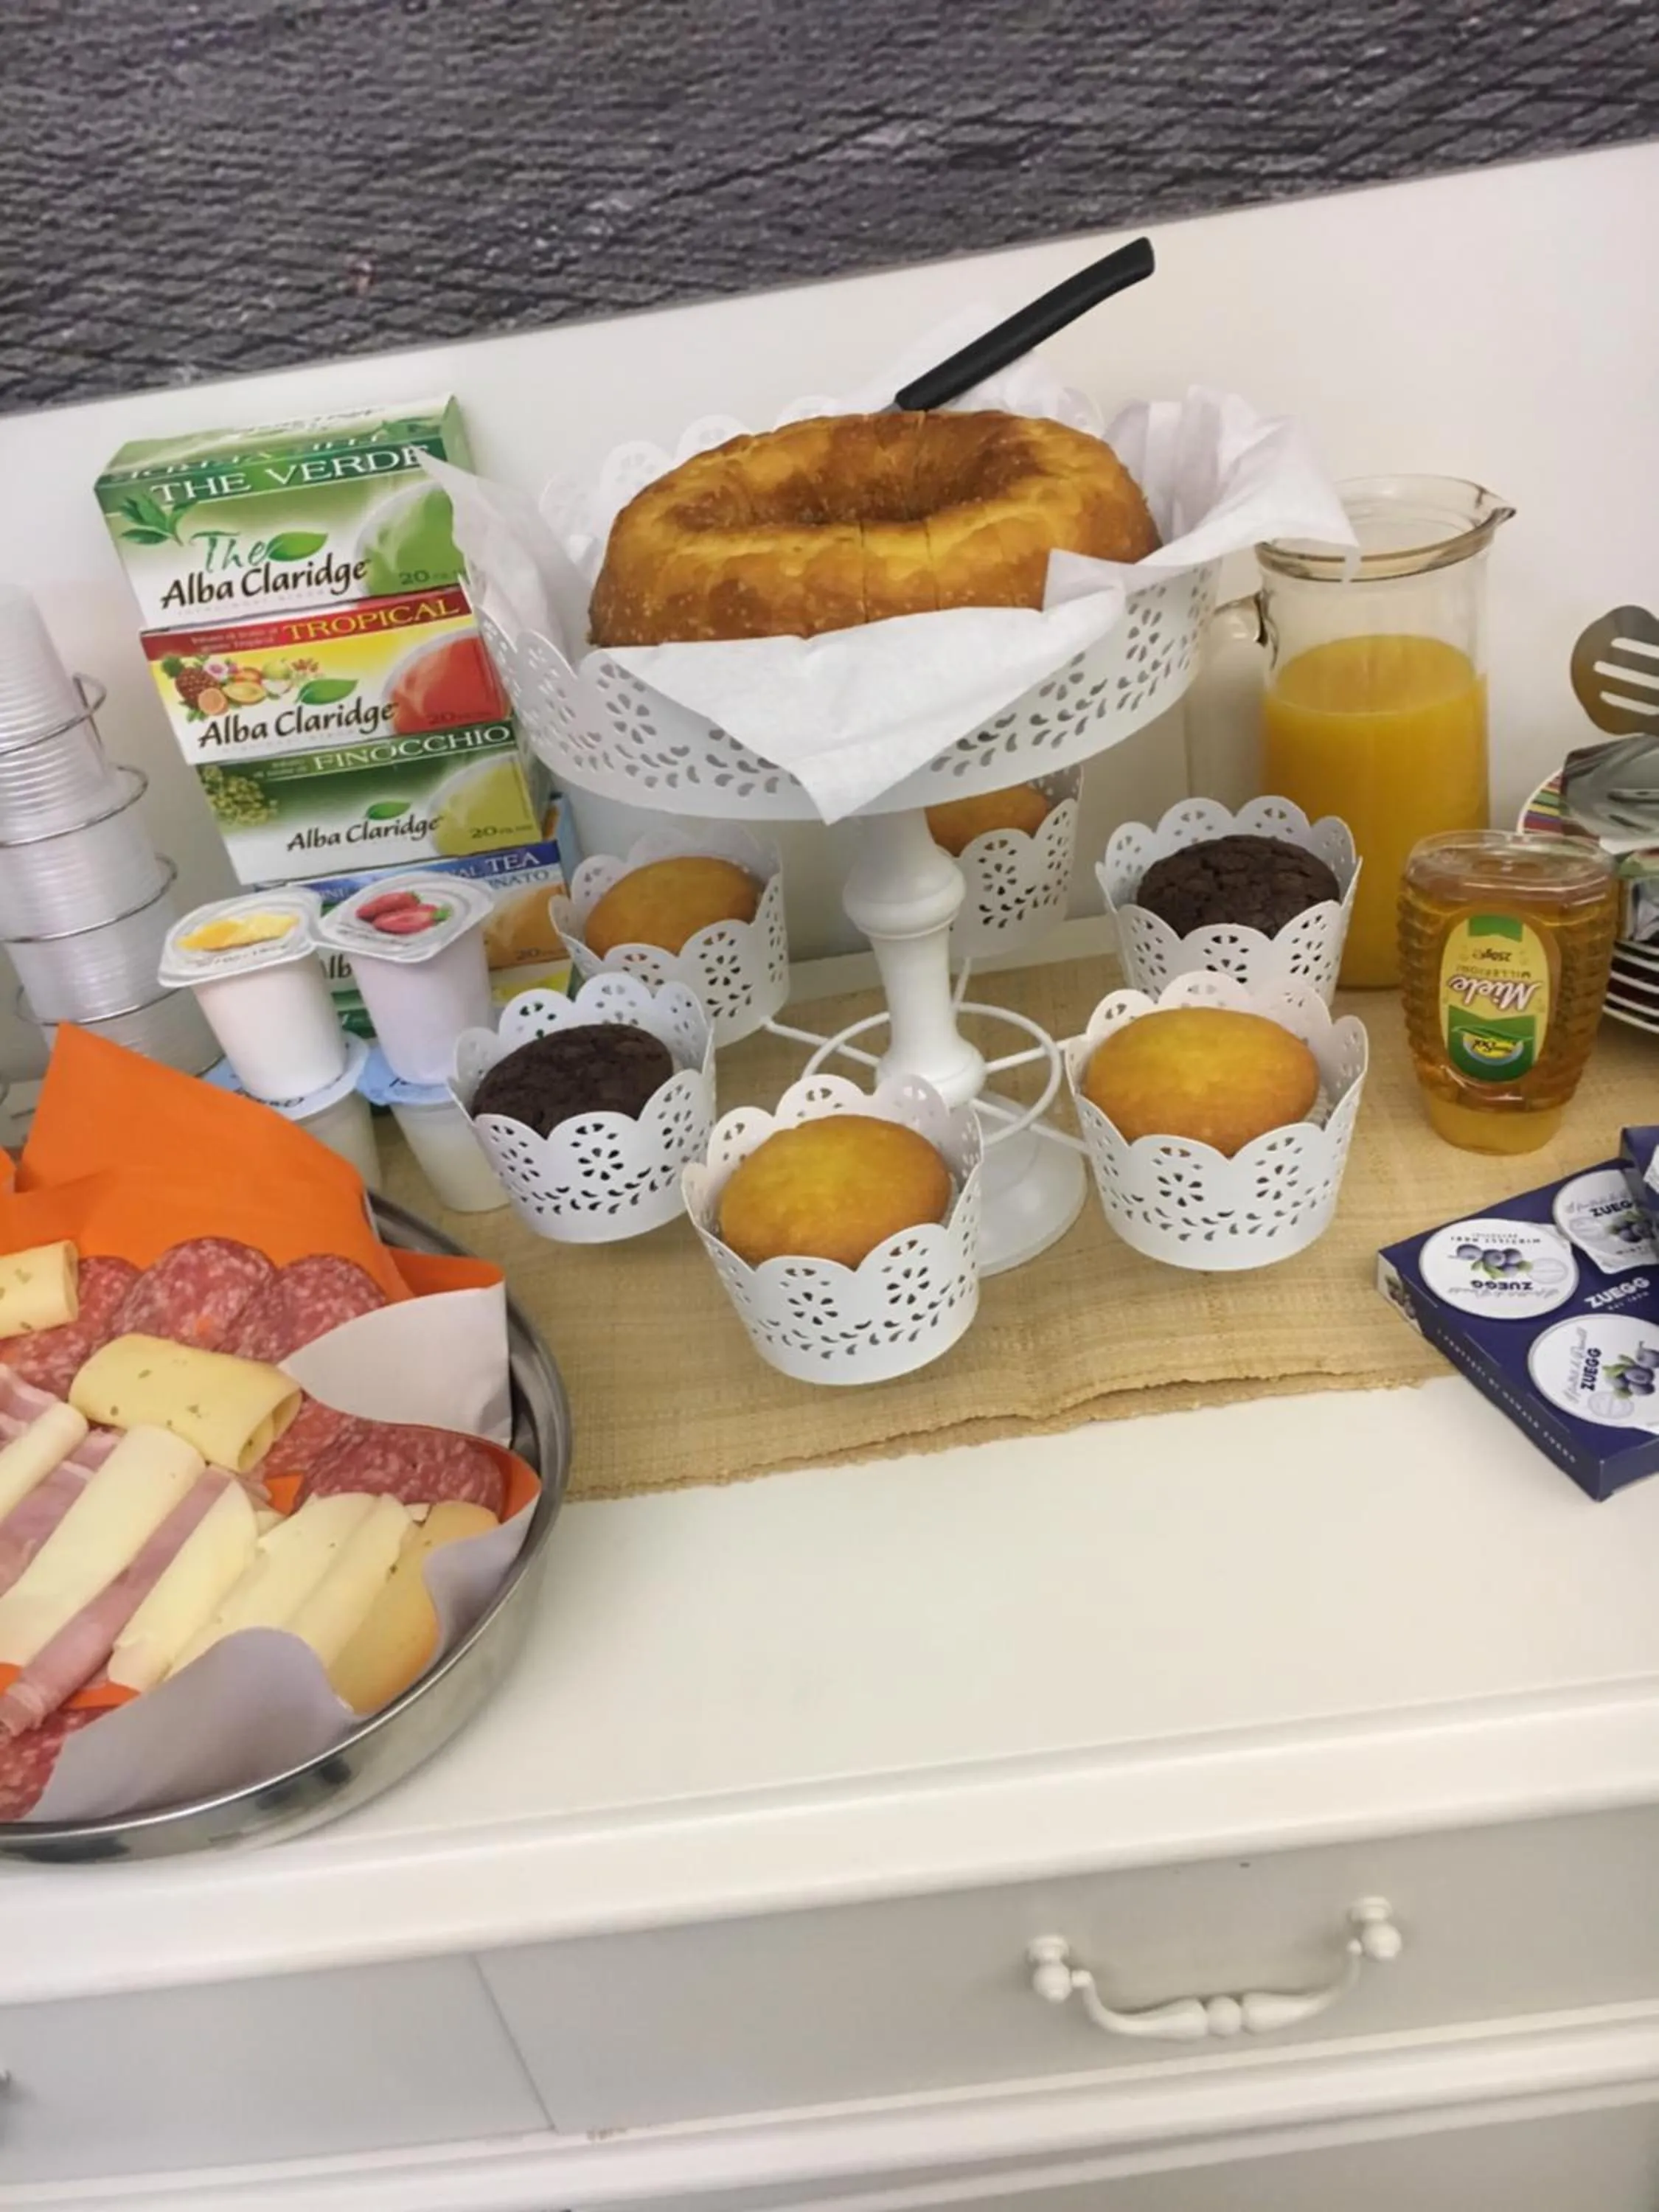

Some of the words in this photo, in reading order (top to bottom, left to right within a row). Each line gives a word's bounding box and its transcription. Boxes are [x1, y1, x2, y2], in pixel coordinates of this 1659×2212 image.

[151, 473, 250, 504] THE
[264, 445, 431, 487] VERDE
[189, 529, 270, 573] The
[160, 572, 234, 610] Alba
[241, 552, 369, 595] Claridge
[399, 570, 430, 585] 20
[283, 598, 461, 641] TROPICAL
[198, 714, 268, 749] Alba
[274, 696, 399, 736] Claridge
[313, 724, 510, 771] FINOCCHIO
[286, 827, 341, 852] Alba
[345, 813, 445, 846] Claridge
[469, 825, 498, 839] 20
[485, 852, 540, 873] TEA
[1449, 976, 1541, 1010] Miele
[1589, 1200, 1633, 1217] ZUEG
[1470, 1280, 1534, 1291] ZUEGG
[1584, 1276, 1651, 1310] ZUEGG
[1580, 1347, 1602, 1391] ZUEGG
